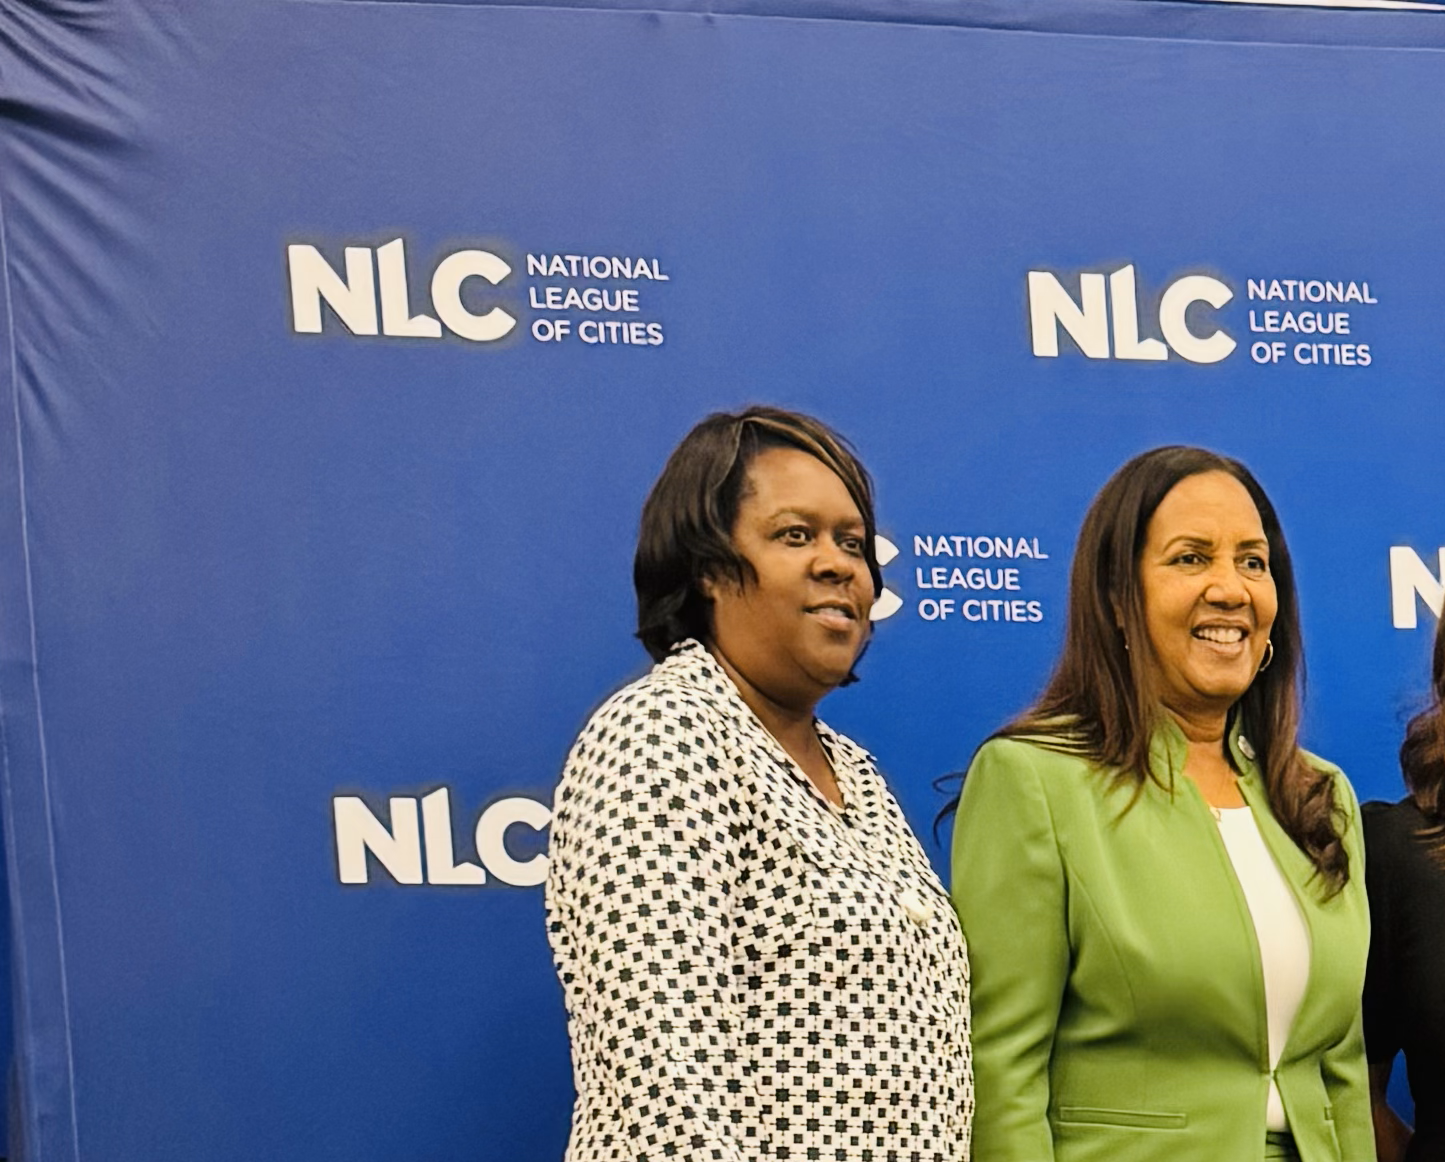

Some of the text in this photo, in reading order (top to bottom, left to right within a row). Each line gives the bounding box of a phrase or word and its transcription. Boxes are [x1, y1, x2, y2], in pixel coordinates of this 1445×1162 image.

[526, 253, 669, 281] NATIONAL
[287, 237, 517, 341] NLC
[529, 286, 640, 312] LEAGUE
[1247, 279, 1378, 304] NATIONAL
[1027, 263, 1237, 364] NLC
[1249, 310, 1350, 335] LEAGUE
[531, 319, 664, 346] OF CITIES
[1251, 341, 1372, 367] OF CITIES
[913, 535, 1049, 559] NATIONAL
[916, 567, 1021, 591] LEAGUE
[918, 599, 1043, 623] OF CITIES
[333, 787, 552, 887] NLC
